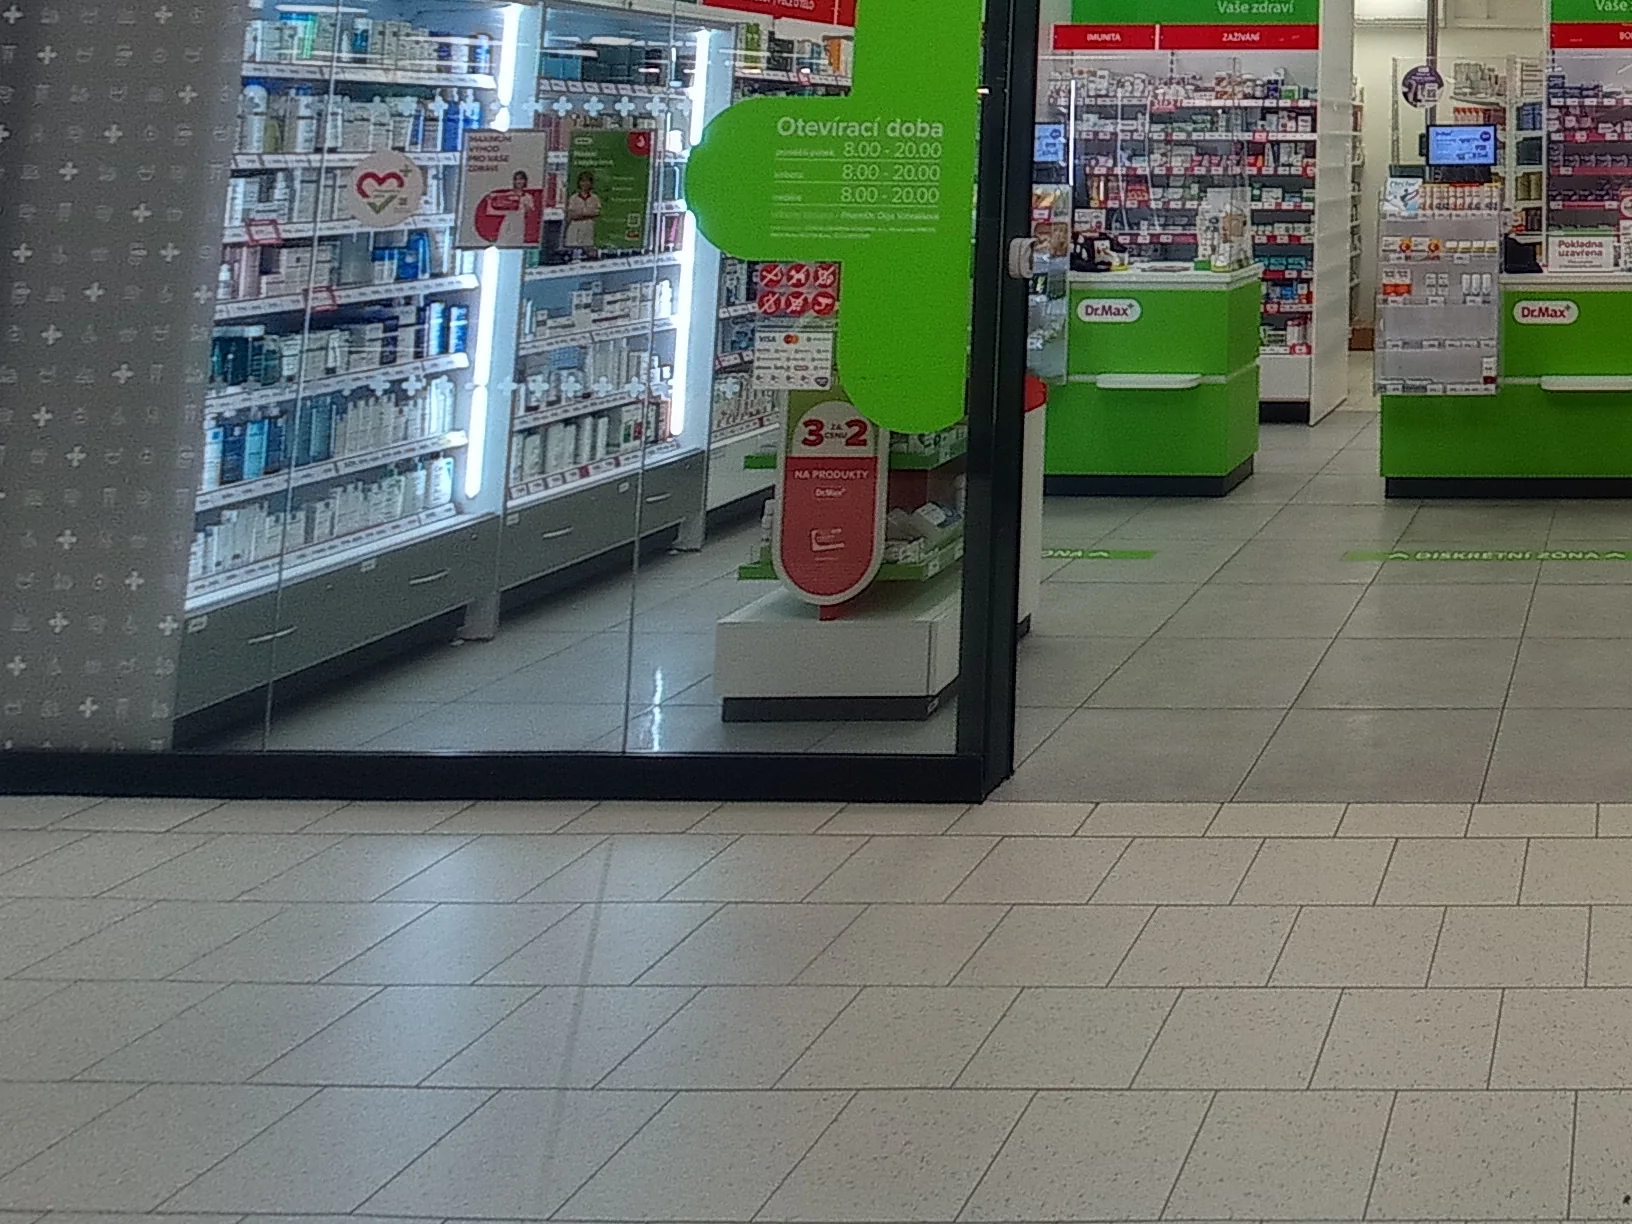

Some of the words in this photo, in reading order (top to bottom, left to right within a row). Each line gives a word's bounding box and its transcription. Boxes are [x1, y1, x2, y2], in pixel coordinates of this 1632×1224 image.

[1216, 0, 1251, 14] Vaše
[1252, 0, 1295, 14] zdraví
[777, 116, 881, 137] Otevírací
[886, 117, 945, 138] doba
[843, 141, 882, 158] 8.00
[894, 142, 942, 159] 20.00
[842, 163, 880, 180] 8.00
[892, 164, 941, 181] 20.00
[840, 186, 878, 203] 8.00
[891, 187, 940, 203] 20.00
[1557, 239, 1604, 248] Pokladna
[1557, 249, 1603, 257] uzavřena
[802, 418, 825, 447] 3
[845, 418, 869, 447] 2
[794, 469, 810, 479] NA
[812, 469, 869, 480] PRODUKTY
